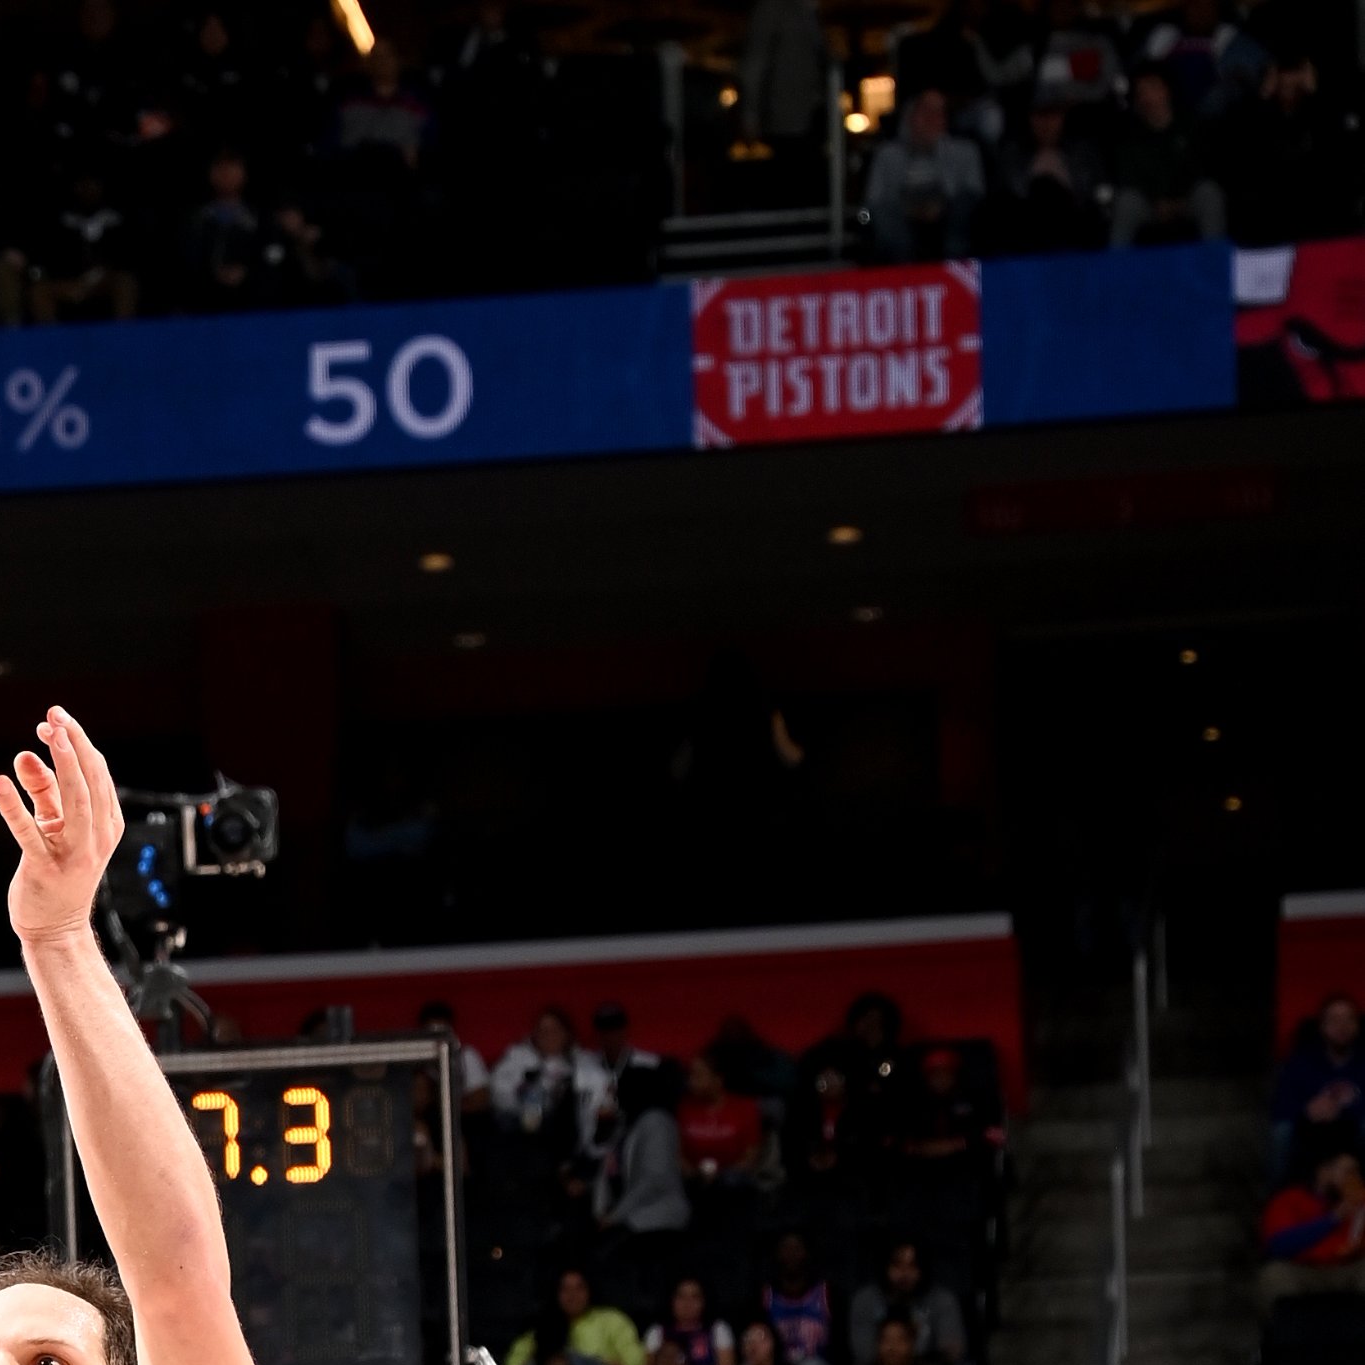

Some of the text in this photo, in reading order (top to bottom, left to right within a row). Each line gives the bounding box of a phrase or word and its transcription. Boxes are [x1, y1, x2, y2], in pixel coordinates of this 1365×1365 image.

[726, 284, 947, 357] DETROIT
[305, 334, 473, 446] 50
[727, 346, 950, 421] PISTONS
[192, 1087, 331, 1186] 7.3
